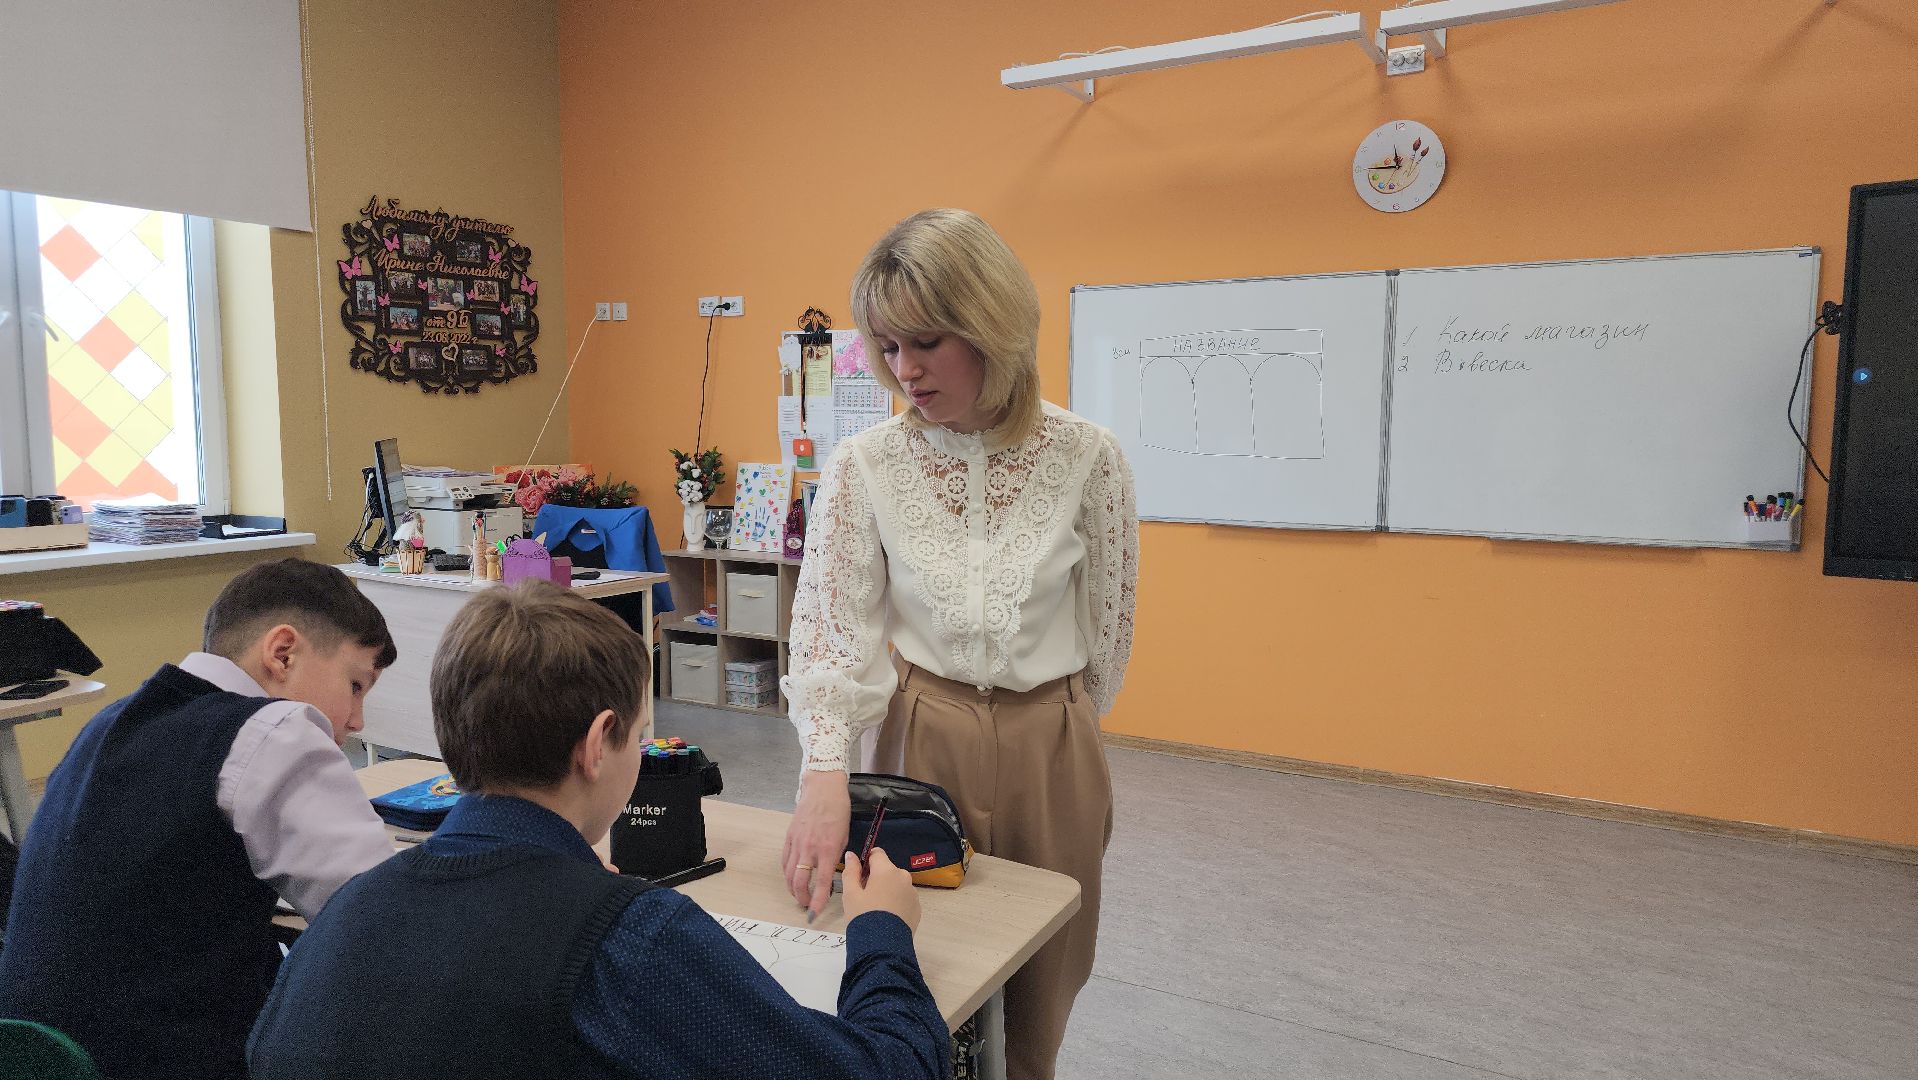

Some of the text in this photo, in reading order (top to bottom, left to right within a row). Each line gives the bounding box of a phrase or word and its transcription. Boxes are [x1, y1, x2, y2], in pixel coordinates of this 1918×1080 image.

[360, 195, 515, 241] Любимому учителю
[1525, 322, 1650, 351] магазин
[623, 803, 667, 816] Marker
[630, 817, 657, 828] 24pcs
